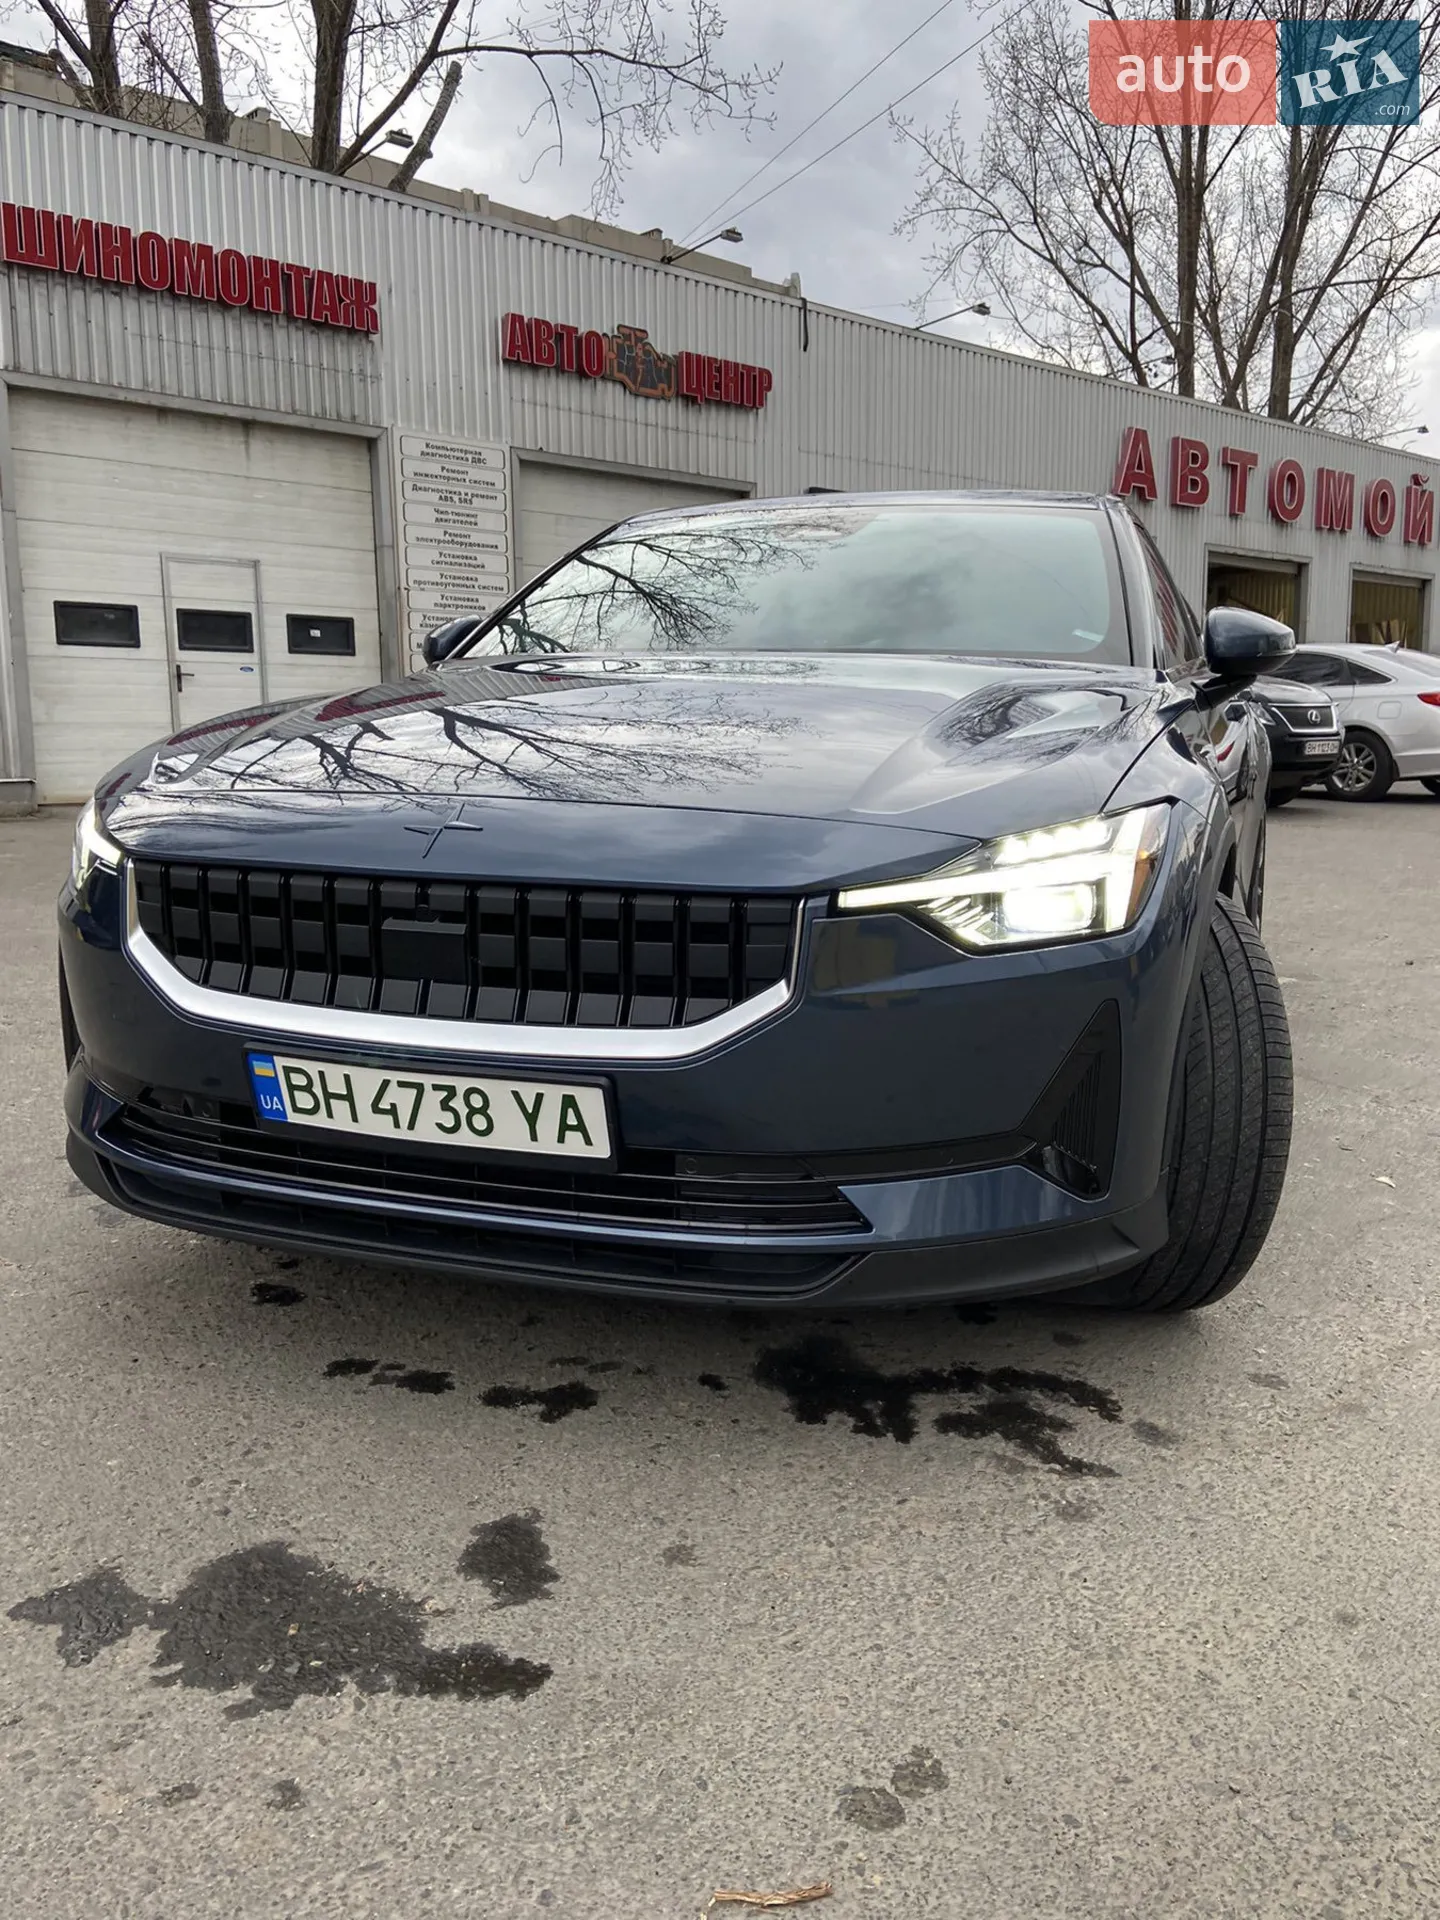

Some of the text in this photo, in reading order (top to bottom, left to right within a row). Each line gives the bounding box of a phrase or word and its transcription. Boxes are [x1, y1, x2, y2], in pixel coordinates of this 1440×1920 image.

[0, 202, 379, 335] ШИНОМОНТАЖ
[502, 312, 773, 409] АВТО ЦЕНТР
[425, 441, 482, 456] Компьютерная
[420, 450, 487, 465] диагностика ДВС
[440, 465, 469, 476] Ремонт
[413, 471, 496, 487] инжекторных систем
[1112, 426, 1440, 546] АВТОМОЙ
[412, 483, 462, 497] Диагностика
[470, 492, 498, 501] ремонт
[433, 507, 479, 519] Чип-тюнинг
[434, 516, 479, 527] двигателей
[443, 530, 471, 540] Ремонт
[415, 536, 499, 550] электрооборудования
[438, 551, 478, 561] Установка
[439, 572, 479, 583] Установка
[413, 579, 505, 592] противоугонных систем
[440, 593, 480, 603] Установка
[433, 602, 487, 611] парктроников
[260, 1094, 284, 1112] UA
[282, 1064, 594, 1147] BH 4738 YA
